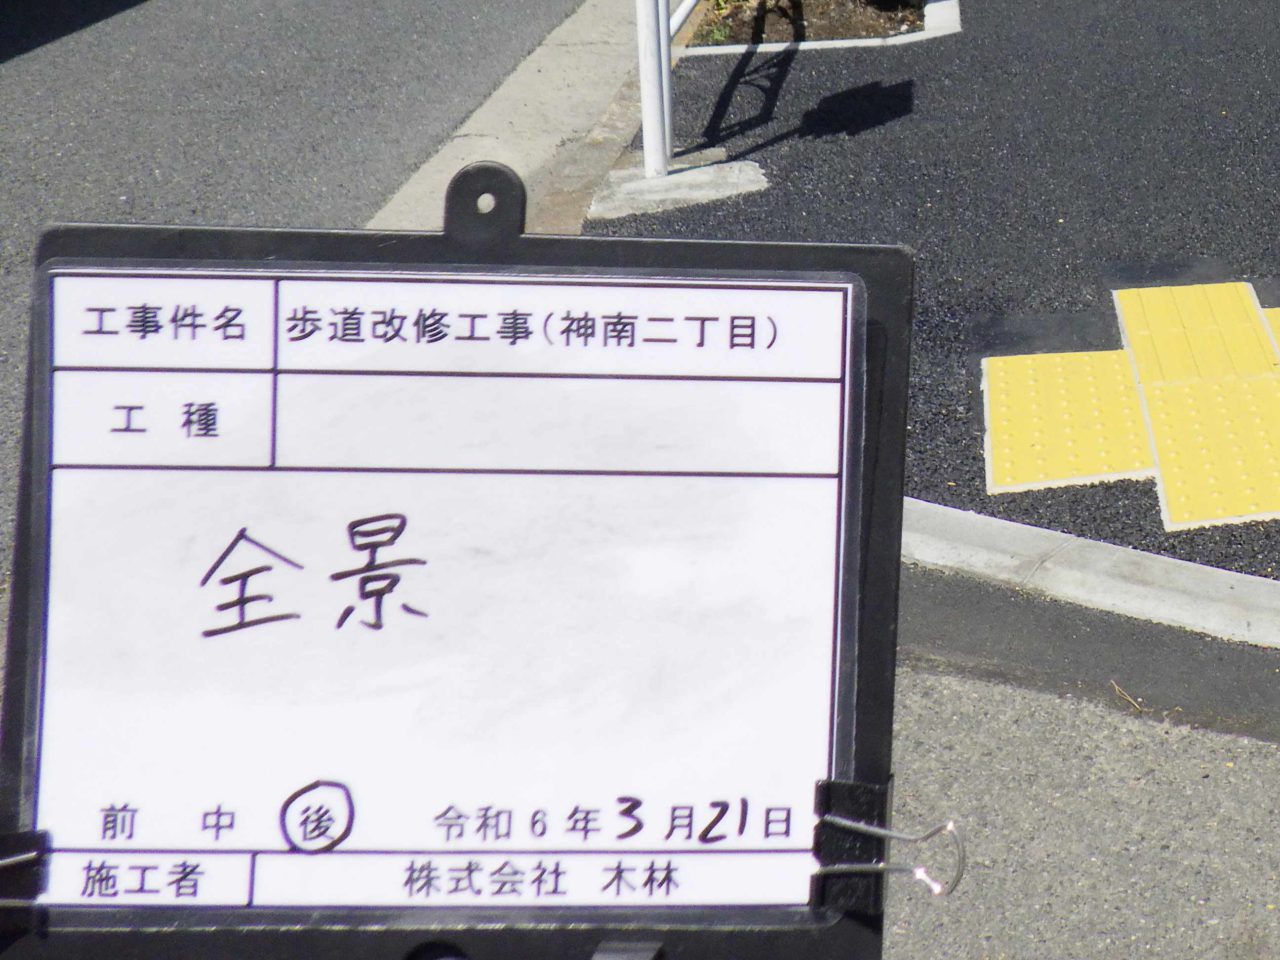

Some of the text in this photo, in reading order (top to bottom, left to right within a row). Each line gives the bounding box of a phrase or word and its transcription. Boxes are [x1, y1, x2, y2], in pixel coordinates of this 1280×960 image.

[83, 303, 246, 342] 工事件名
[286, 306, 779, 350] 歩道改修工事(神南二丁目)
[200, 512, 428, 638] 全景
[80, 860, 204, 898] 施工者
